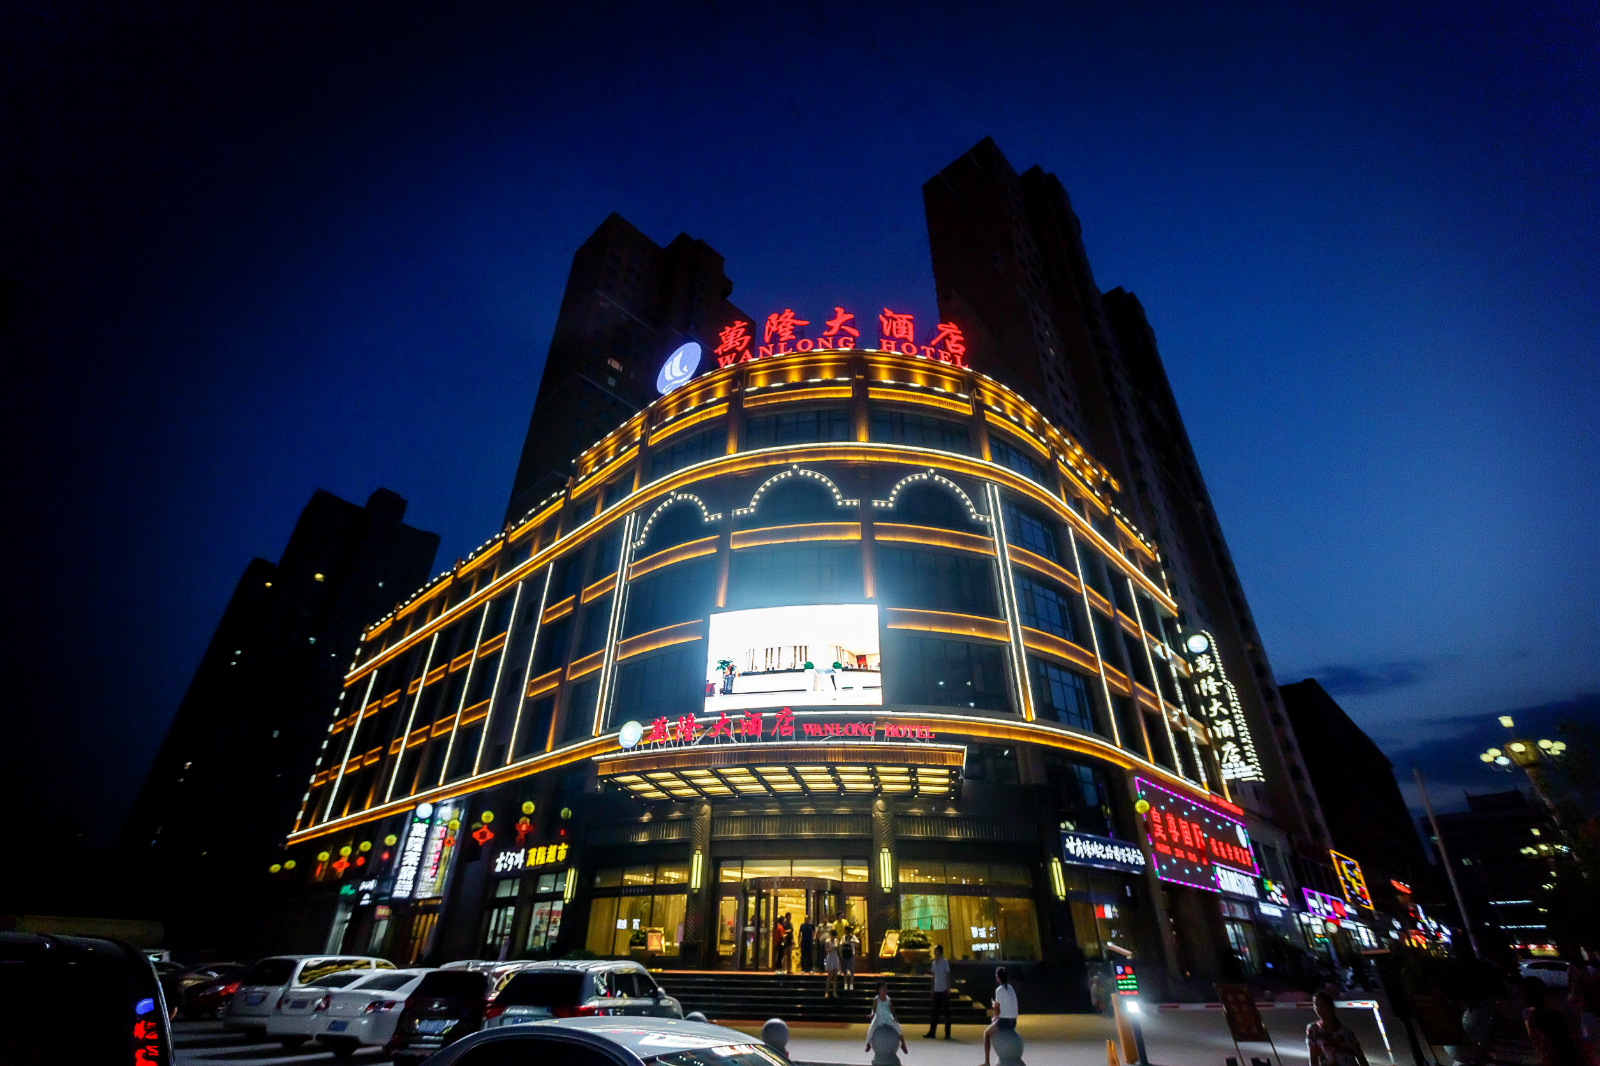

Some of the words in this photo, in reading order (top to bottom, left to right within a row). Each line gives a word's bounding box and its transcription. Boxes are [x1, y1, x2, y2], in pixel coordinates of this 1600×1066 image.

[714, 307, 967, 355] 萬隆大酒店
[717, 336, 856, 369] WANLONG
[879, 338, 968, 368] HOTEL
[648, 706, 796, 743] 萬隆大酒店
[1194, 653, 1242, 764] 萬隆大酒店
[802, 721, 876, 737] WANLONG
[884, 723, 935, 739] HOTEL
